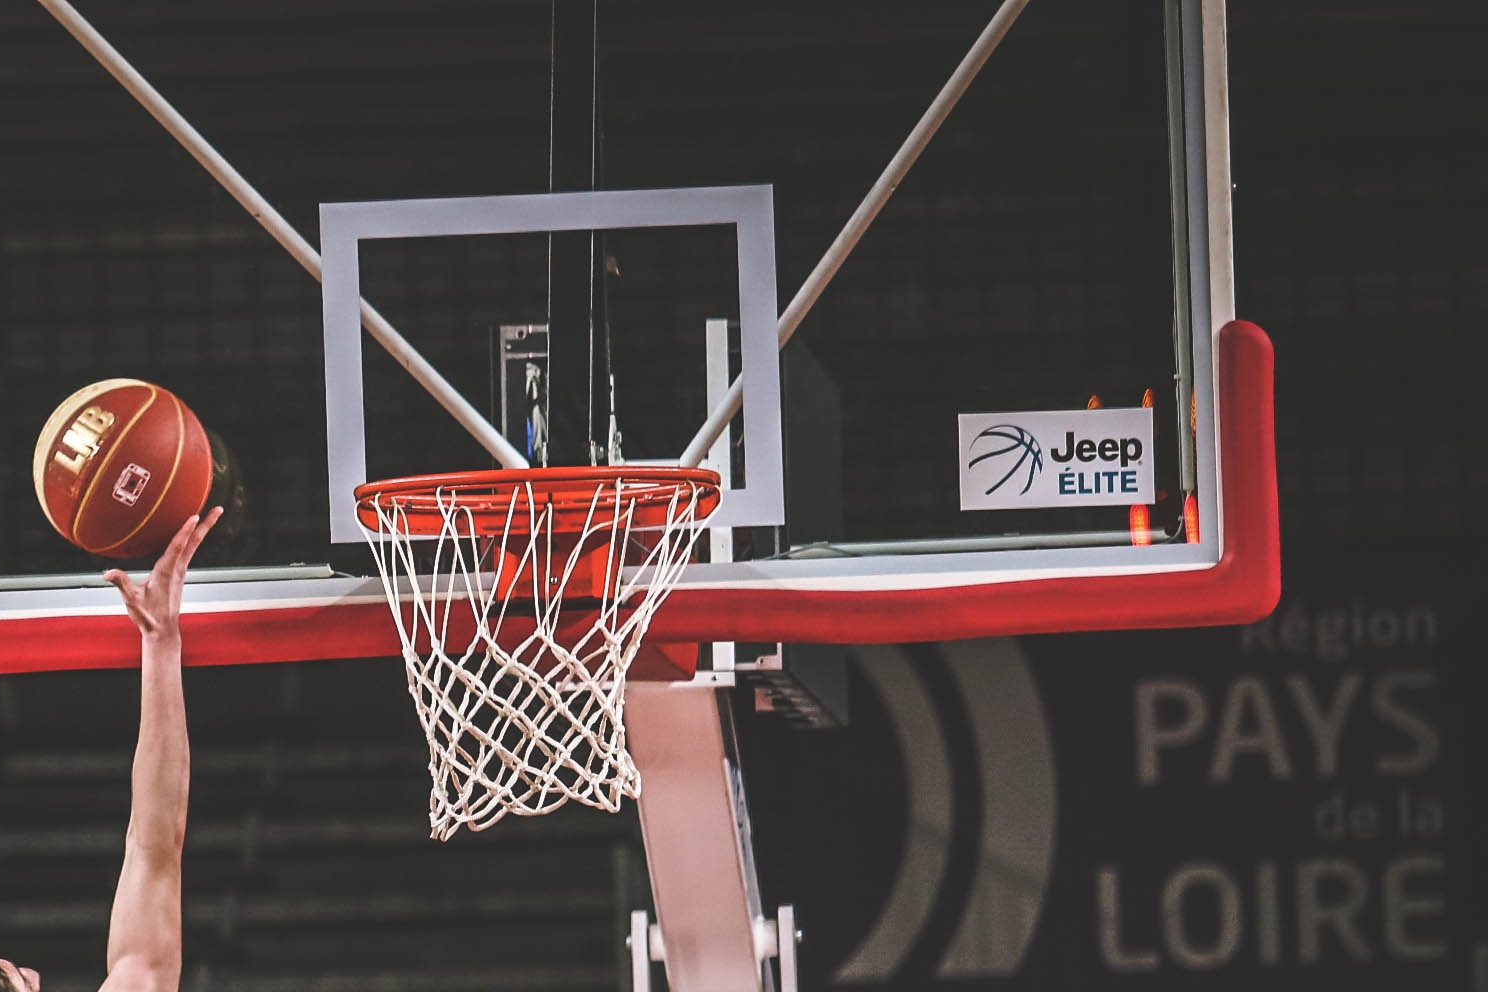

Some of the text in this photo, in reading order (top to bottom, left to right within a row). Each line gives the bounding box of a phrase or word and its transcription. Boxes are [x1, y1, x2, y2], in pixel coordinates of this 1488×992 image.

[1050, 431, 1143, 468] Jeep
[1058, 467, 1139, 495] ÉLITE
[1134, 669, 1440, 787] PAYS
[1315, 794, 1444, 841] de la
[1096, 855, 1447, 973] LOIRE
